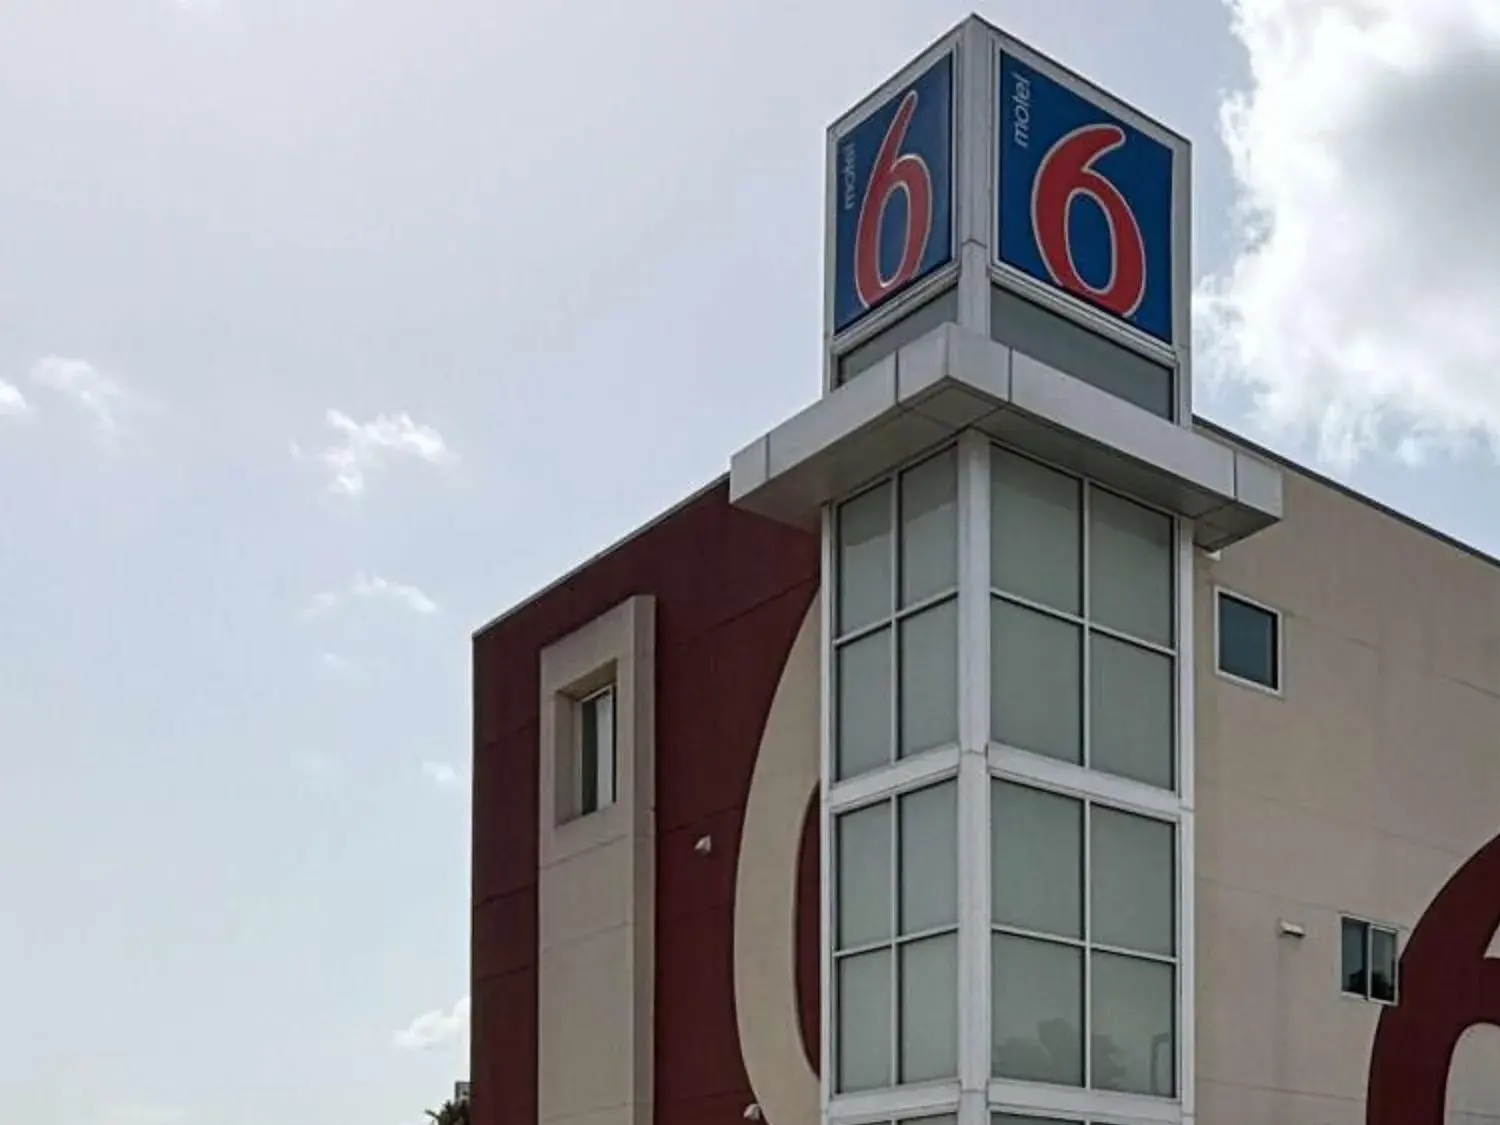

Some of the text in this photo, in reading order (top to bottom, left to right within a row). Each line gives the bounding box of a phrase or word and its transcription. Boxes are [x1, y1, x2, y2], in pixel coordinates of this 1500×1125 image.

[855, 90, 933, 309] 6
[1011, 75, 1146, 318] motel 6
